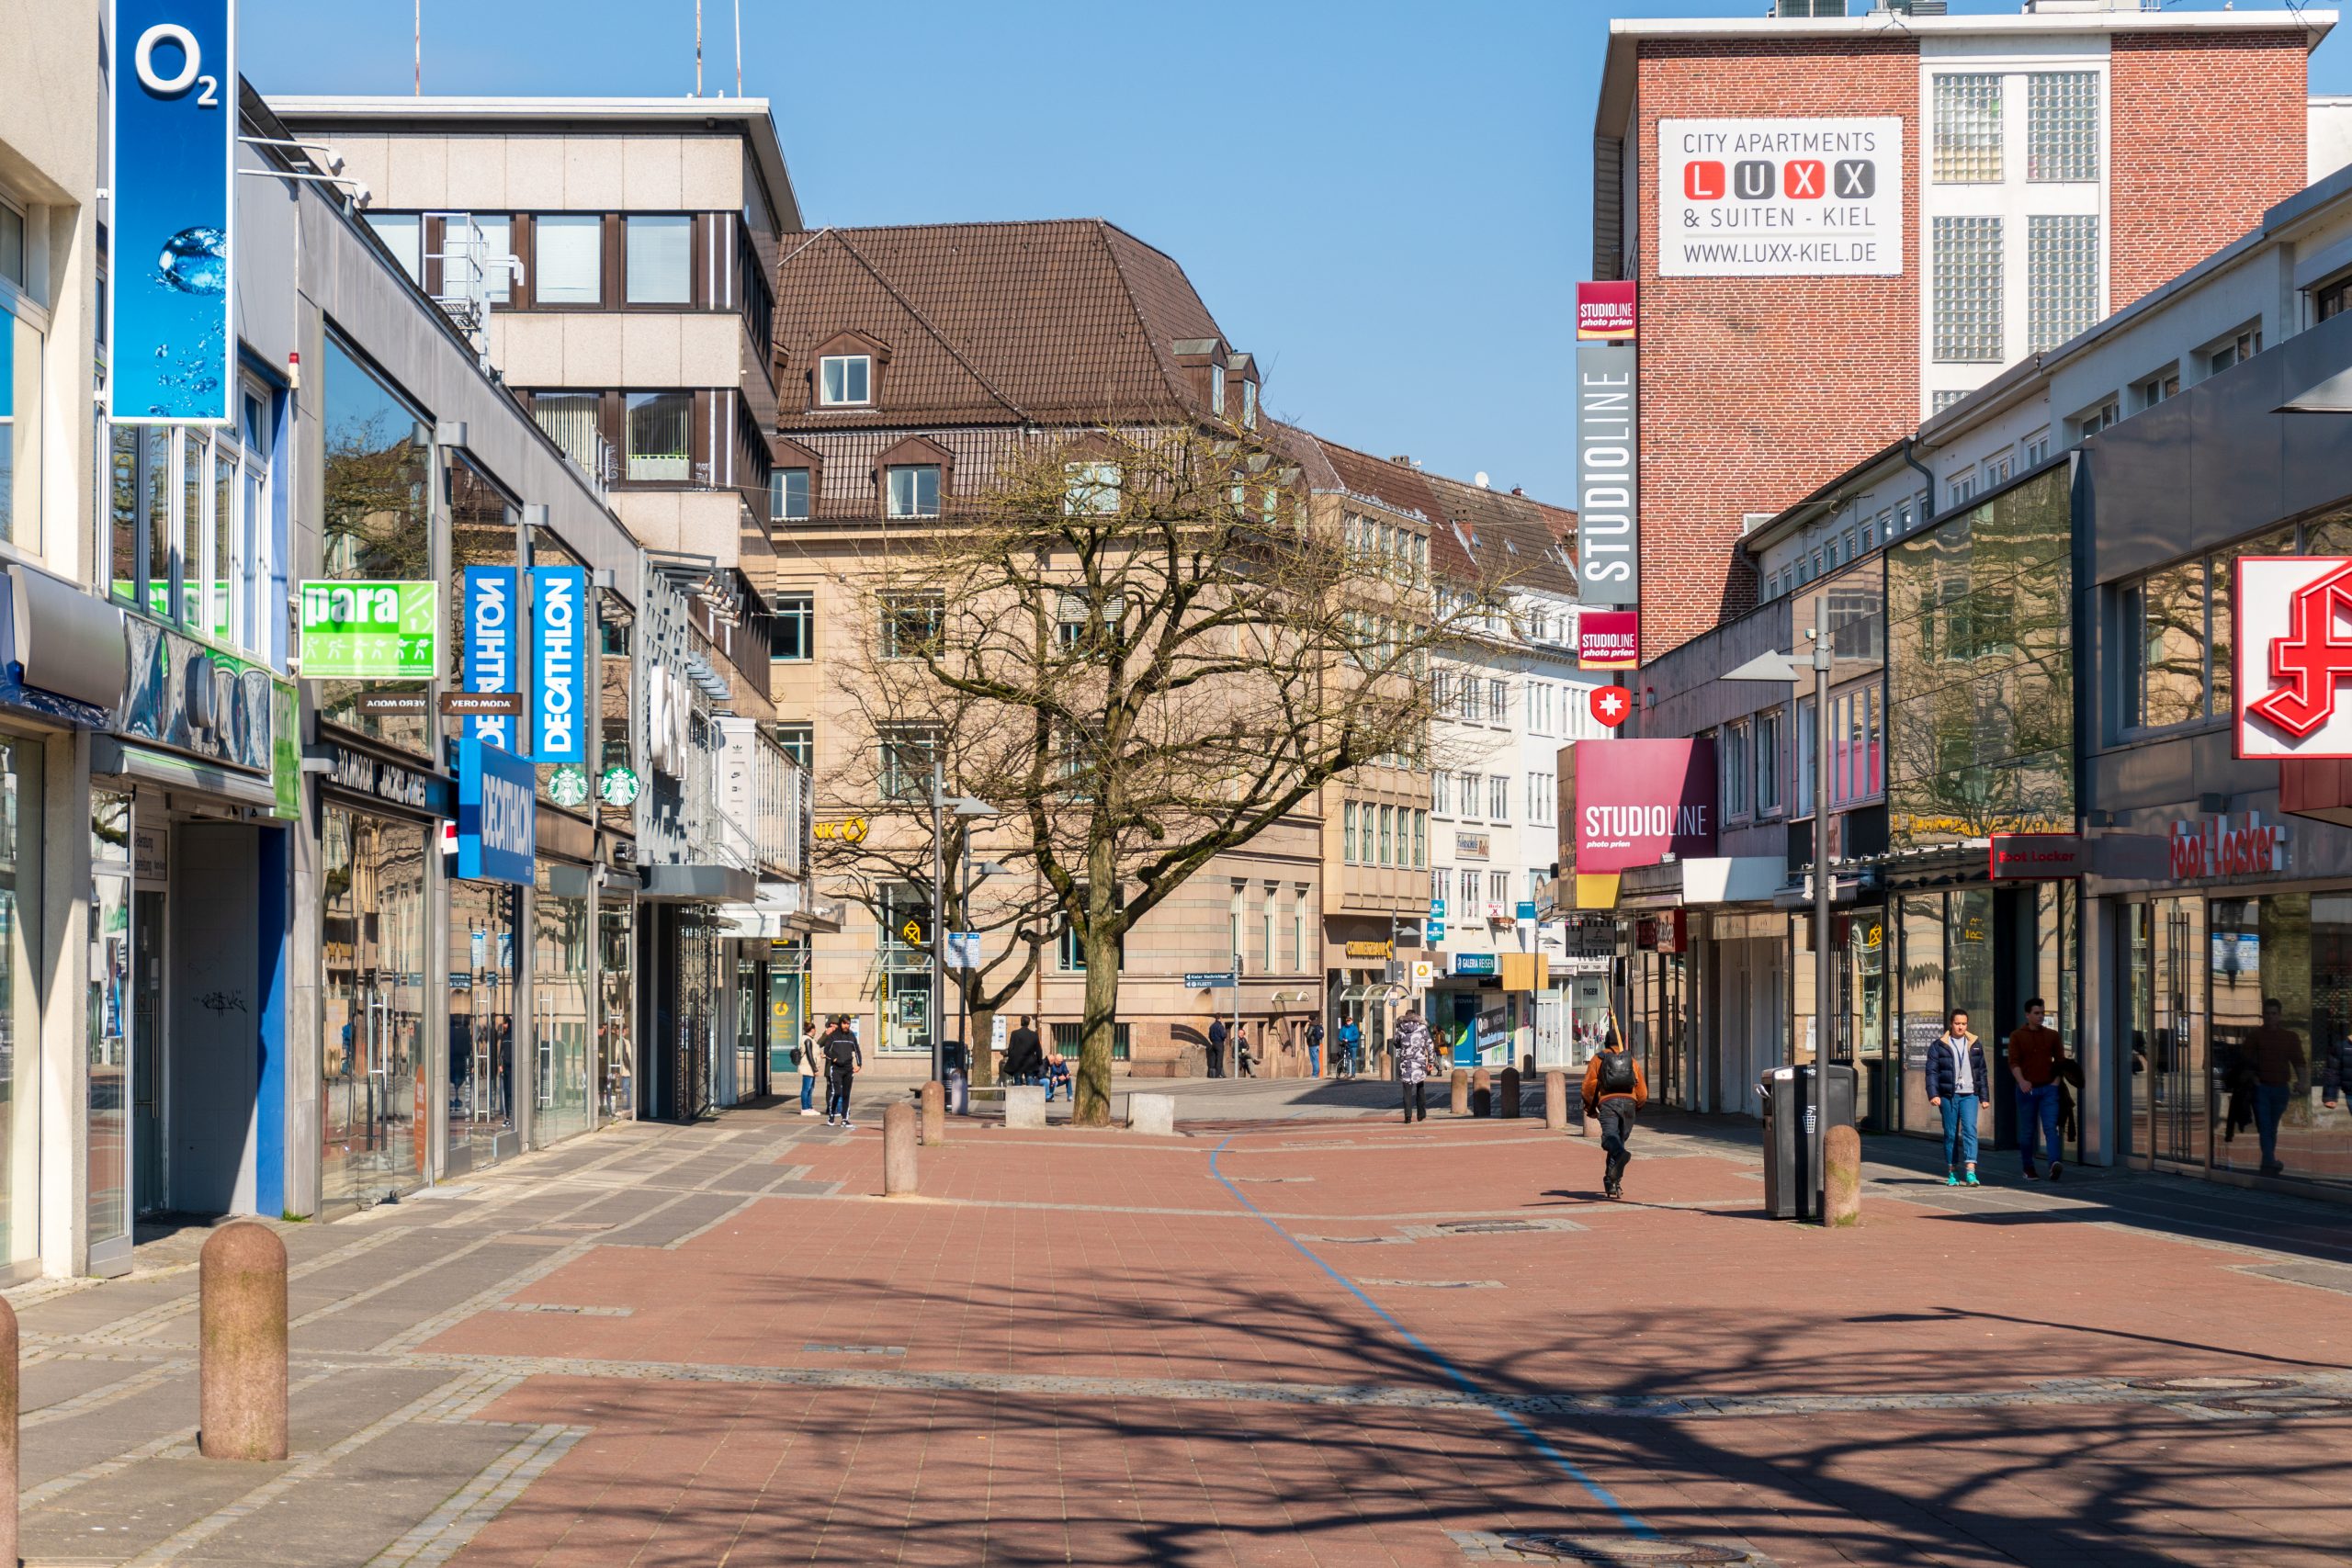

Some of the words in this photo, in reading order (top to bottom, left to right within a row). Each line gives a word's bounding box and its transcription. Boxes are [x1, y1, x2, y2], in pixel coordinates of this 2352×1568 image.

[1683, 133, 1727, 153] CITY
[1735, 131, 1875, 152] APARTMENTS
[1690, 162, 1869, 197] LUXX
[1683, 208, 1701, 228] &
[1711, 208, 1794, 228] SUITEN
[1823, 207, 1876, 227] KIEL
[1683, 243, 1877, 264] WWW.LUXX-KIEL.DE
[1580, 303, 1633, 318] STUDIOLINE
[1580, 319, 1608, 328] photo
[1609, 318, 1634, 327] prien
[1582, 371, 1631, 581] STUDIOLINE
[304, 587, 399, 626] para
[1582, 633, 1634, 648] STUDIOLINE
[1582, 649, 1610, 658] photo
[1611, 649, 1635, 658] prien
[544, 578, 572, 752] DECATHLON
[451, 700, 479, 708] VERO
[480, 700, 511, 708] MODA
[348, 752, 374, 794] MODA
[482, 773, 533, 857] DECATHLON
[1586, 805, 1707, 837] STUDIOLINE
[1587, 840, 1609, 849] photo
[1610, 840, 1631, 849] prien
[2170, 820, 2207, 880] Foot
[2213, 811, 2278, 875] Locker
[1998, 852, 2028, 863] Foot
[2031, 851, 2075, 863] Locker
[1463, 958, 1478, 969] GALERIA
[1478, 958, 1494, 969] REISEN
[1583, 987, 1599, 996] TIGER
